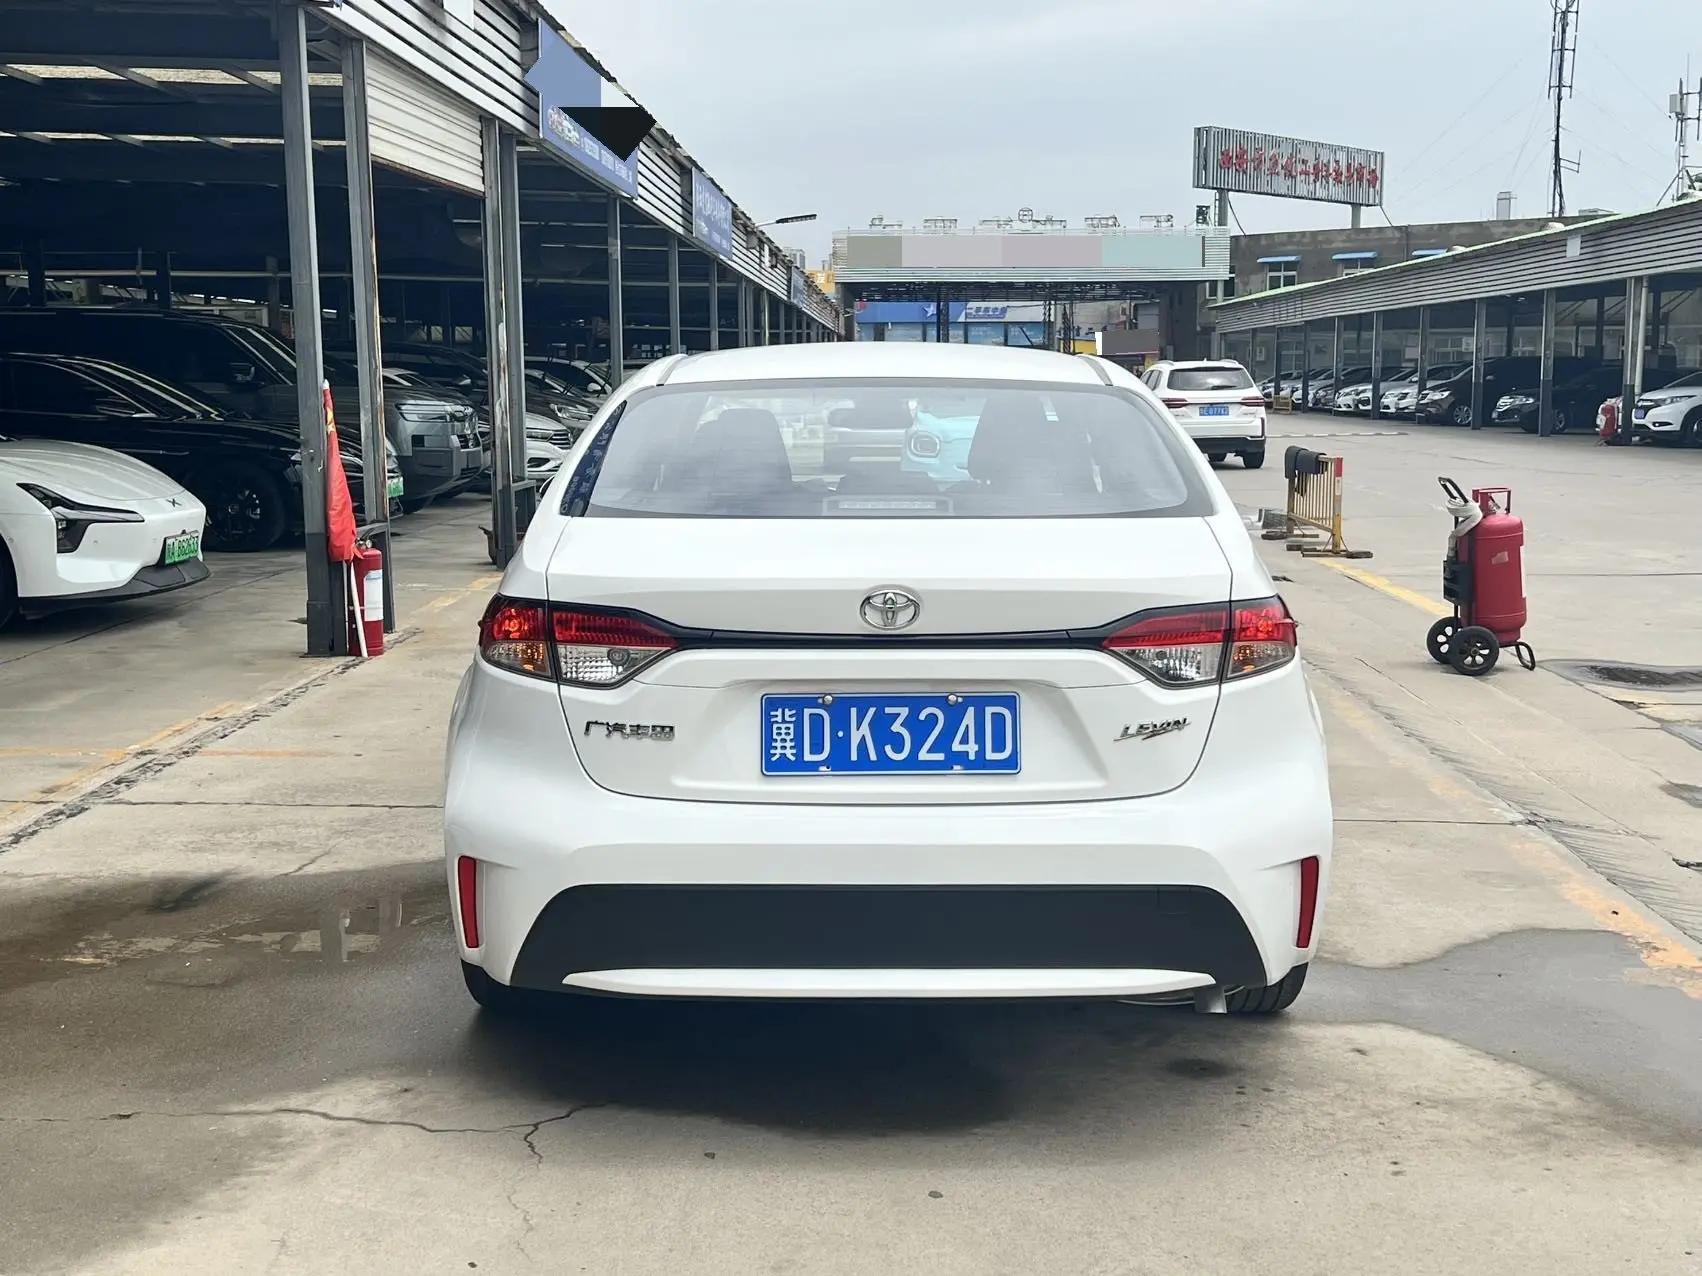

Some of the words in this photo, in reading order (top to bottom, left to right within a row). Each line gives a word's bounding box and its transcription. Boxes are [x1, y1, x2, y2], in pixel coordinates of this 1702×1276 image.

[584, 720, 675, 741] 广汽丰田
[769, 706, 1013, 762] 冀D·K324D
